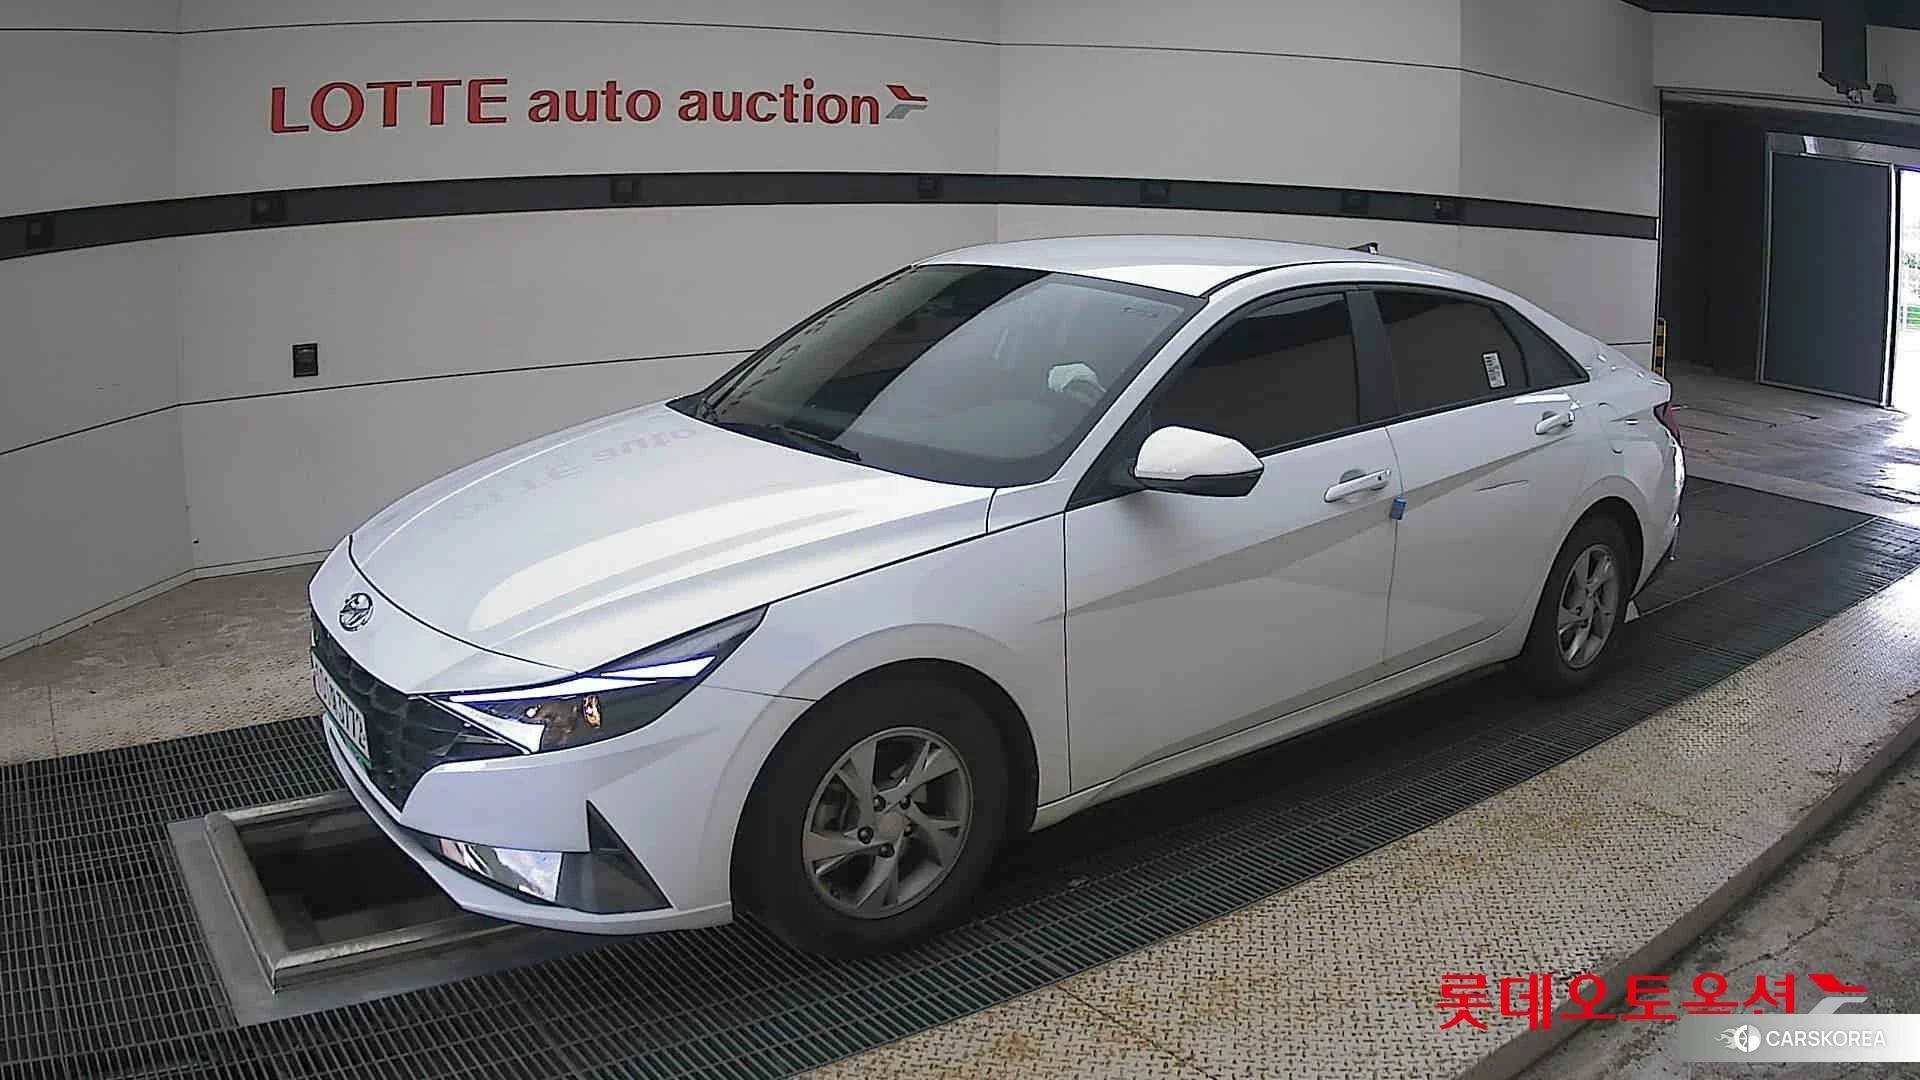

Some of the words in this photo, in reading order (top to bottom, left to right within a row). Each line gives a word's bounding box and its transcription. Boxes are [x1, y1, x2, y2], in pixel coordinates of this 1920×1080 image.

[270, 78, 509, 134] LOTTE
[527, 79, 662, 123] auto
[677, 77, 881, 125] auction
